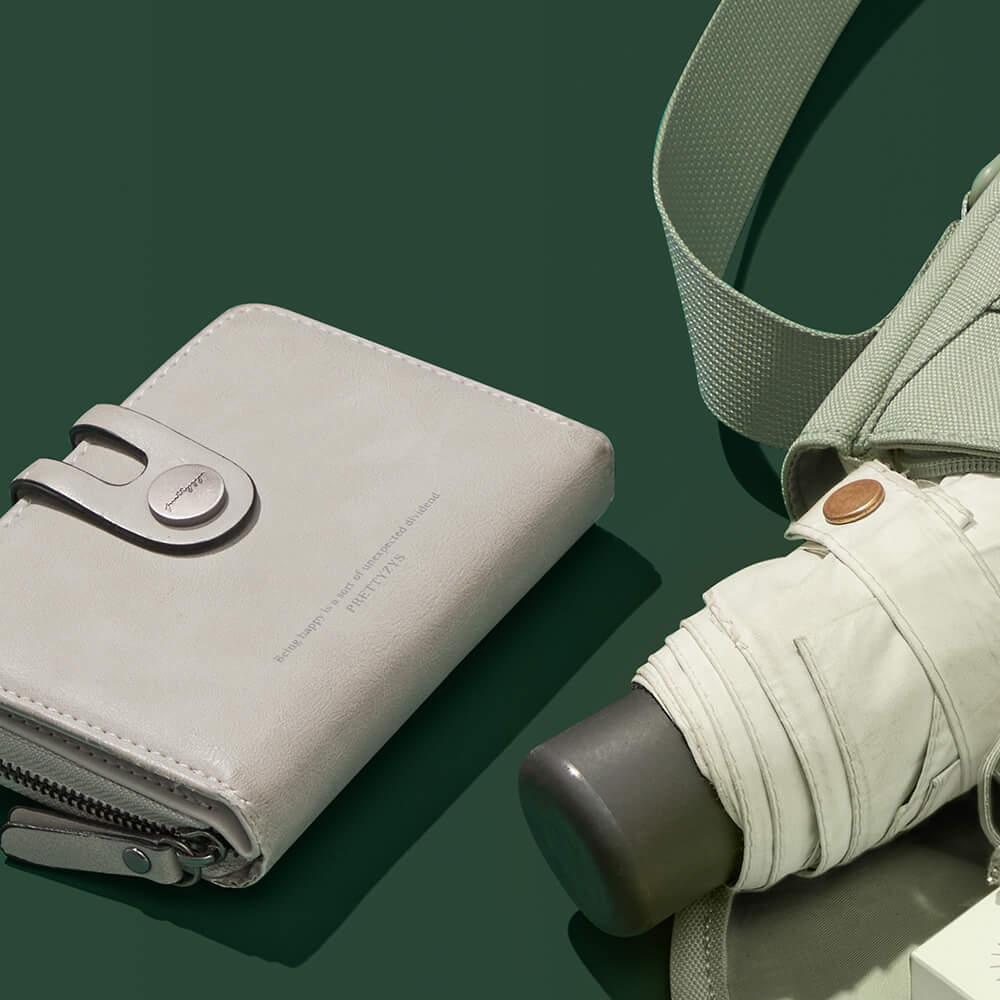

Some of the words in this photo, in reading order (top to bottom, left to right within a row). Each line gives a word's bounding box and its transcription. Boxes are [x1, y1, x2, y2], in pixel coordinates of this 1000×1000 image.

[352, 568, 364, 582] of
[361, 525, 408, 572] unexpected
[404, 490, 441, 527] dividend
